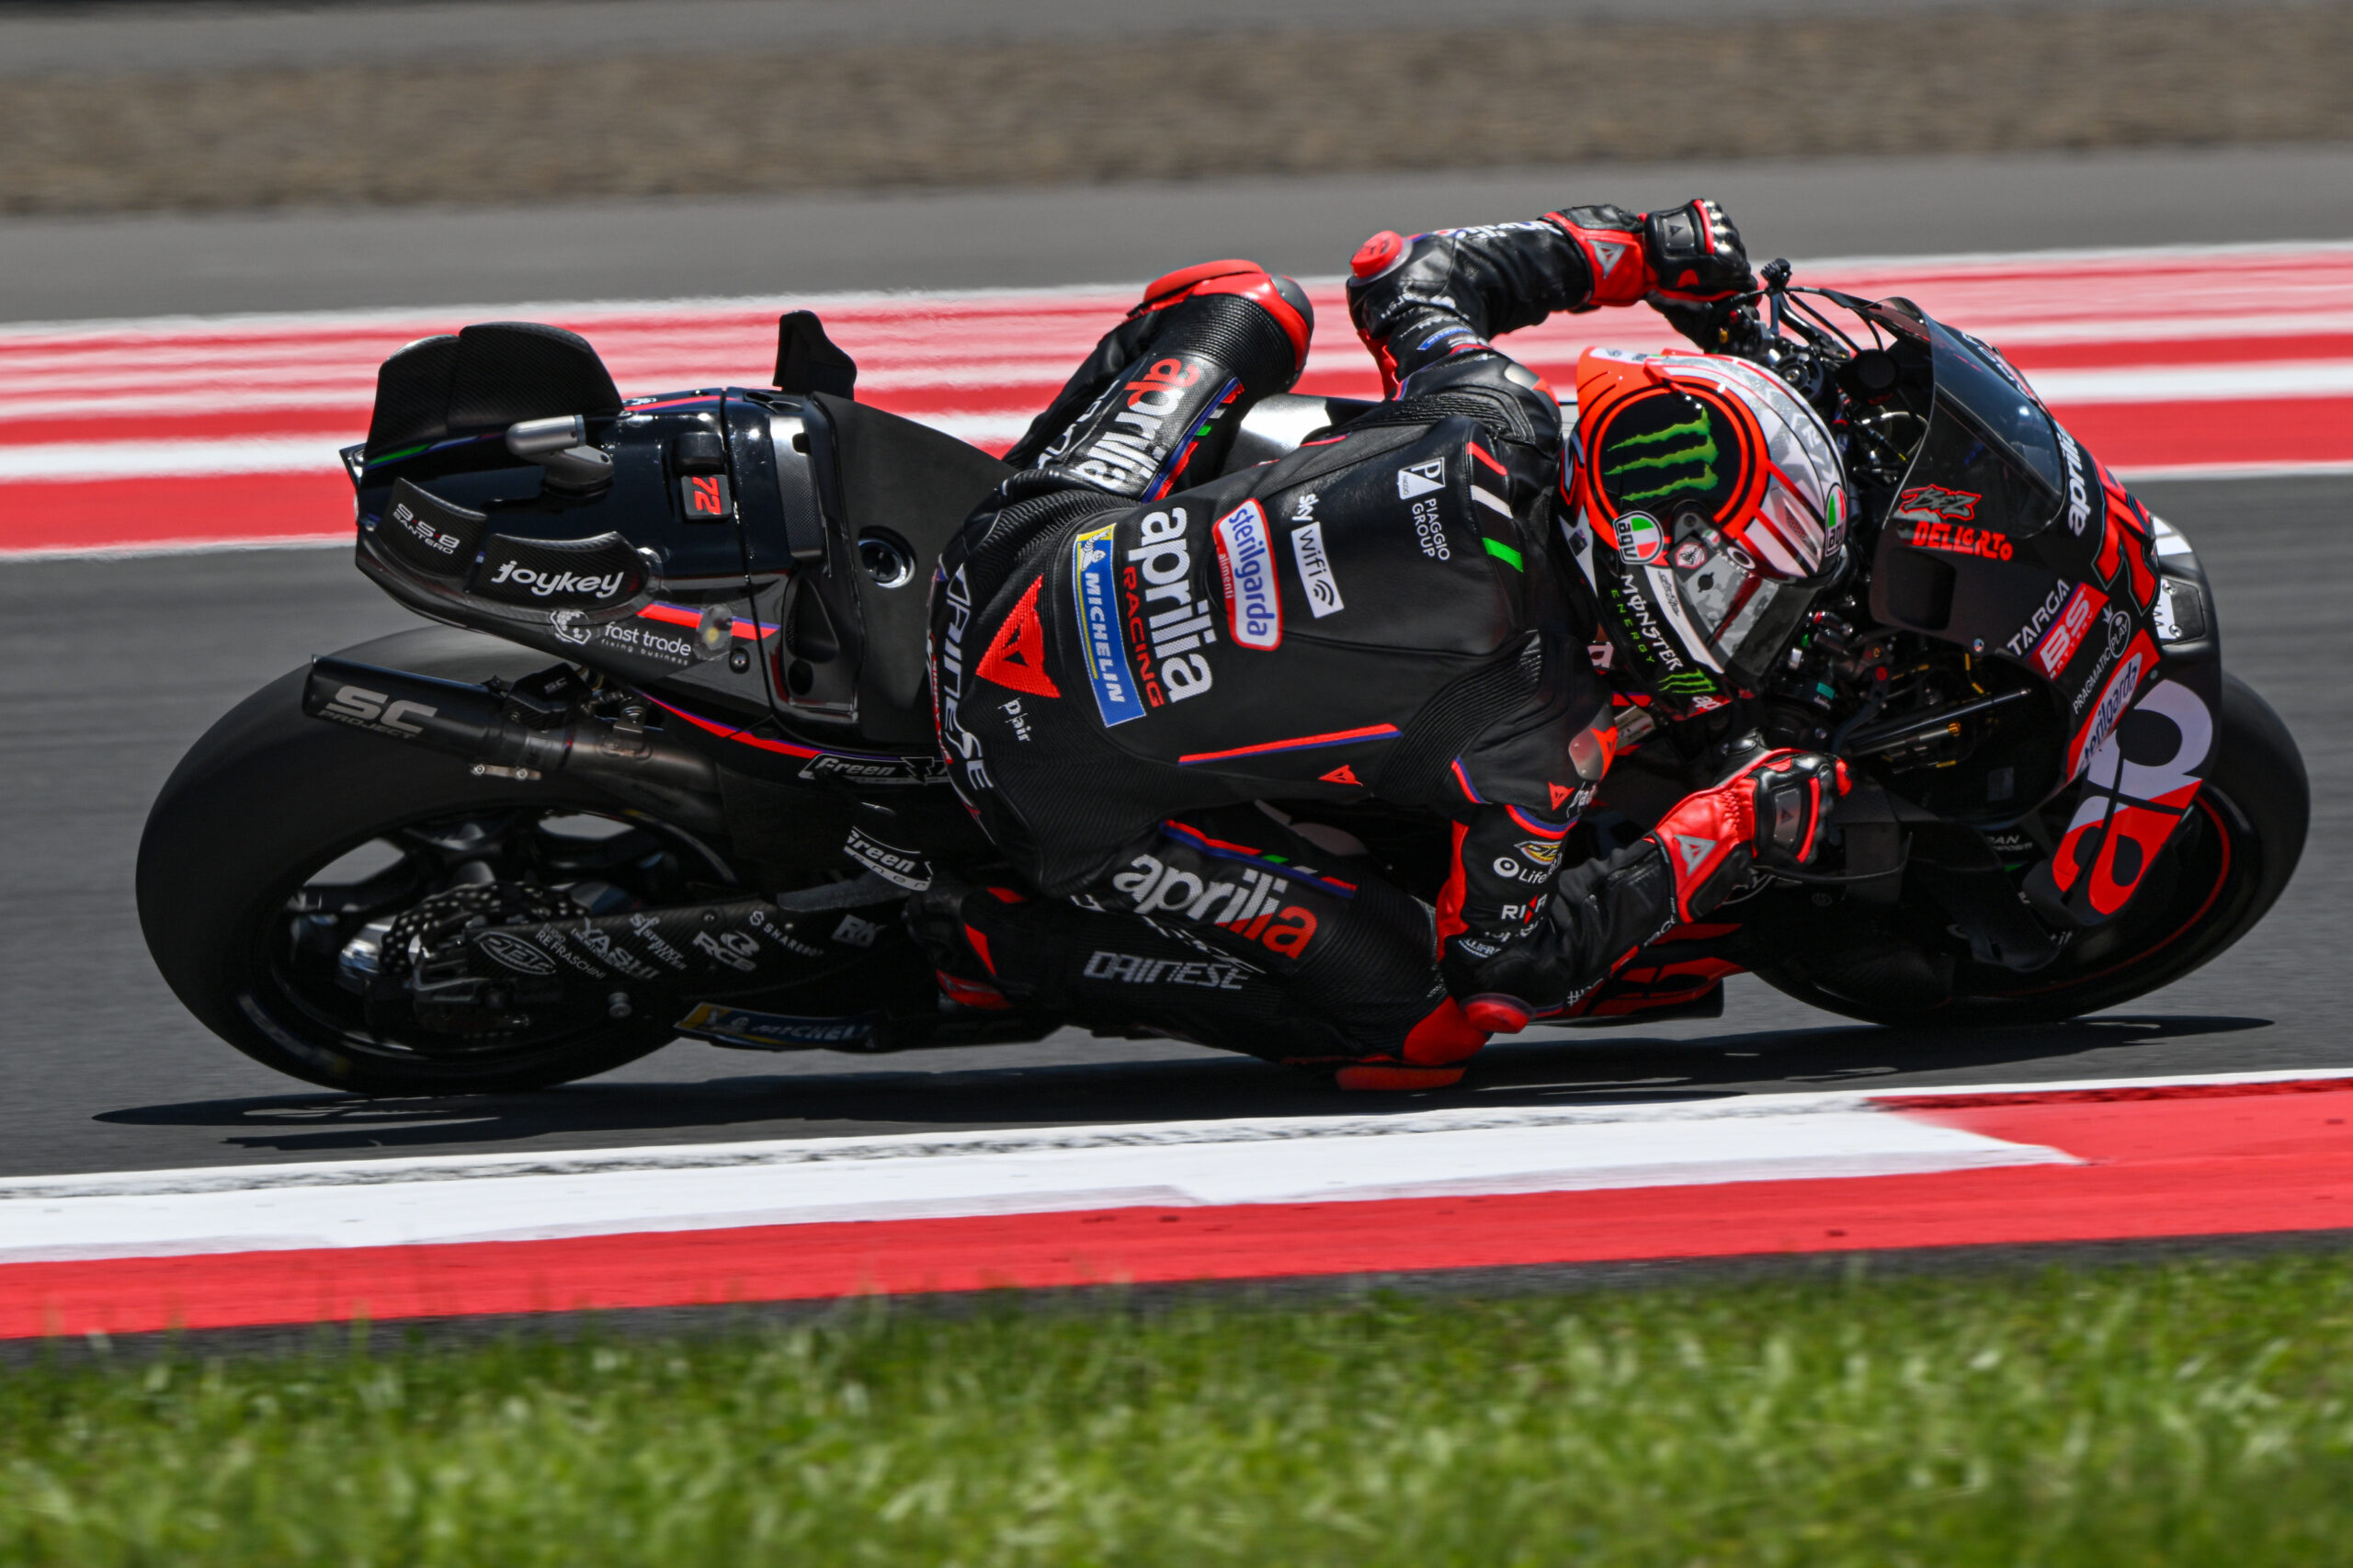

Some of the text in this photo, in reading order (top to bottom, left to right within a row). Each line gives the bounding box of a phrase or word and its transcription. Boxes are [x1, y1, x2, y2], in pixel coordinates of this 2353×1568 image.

[1069, 358, 1199, 490] aprilia
[691, 476, 722, 515] 72
[1290, 493, 1320, 522] sky
[1299, 528, 1327, 577] wifi
[1412, 502, 1436, 558] GROUP
[1424, 497, 1450, 561] PIAGGIO
[1618, 519, 1640, 561] agv
[491, 559, 625, 598] joykey
[1218, 552, 1233, 599] alimenti
[1228, 507, 1276, 637] sterilgarda
[1122, 565, 1165, 708] RACING
[1128, 506, 1217, 703] aprilia
[1611, 589, 1655, 663] ENERGY
[1620, 573, 1684, 671] MONSTER
[2006, 578, 2070, 657] TARGA
[2040, 591, 2090, 674] BS
[604, 620, 692, 656] fast trade
[1085, 572, 1126, 703] MICHELIN
[2050, 610, 2095, 679] BATTERY
[2072, 645, 2112, 716] PRAGMATIC
[2110, 619, 2131, 652] PLAY
[943, 562, 994, 790] DAINESE
[318, 709, 416, 740] PROJECT
[324, 684, 438, 735] SC
[814, 756, 897, 777] Green
[1112, 853, 1318, 960] aprilia
[535, 929, 553, 948] RE
[551, 942, 607, 980] FRASCHINI
[579, 915, 662, 980] YASHI
[1083, 950, 1250, 989] DAINESE
